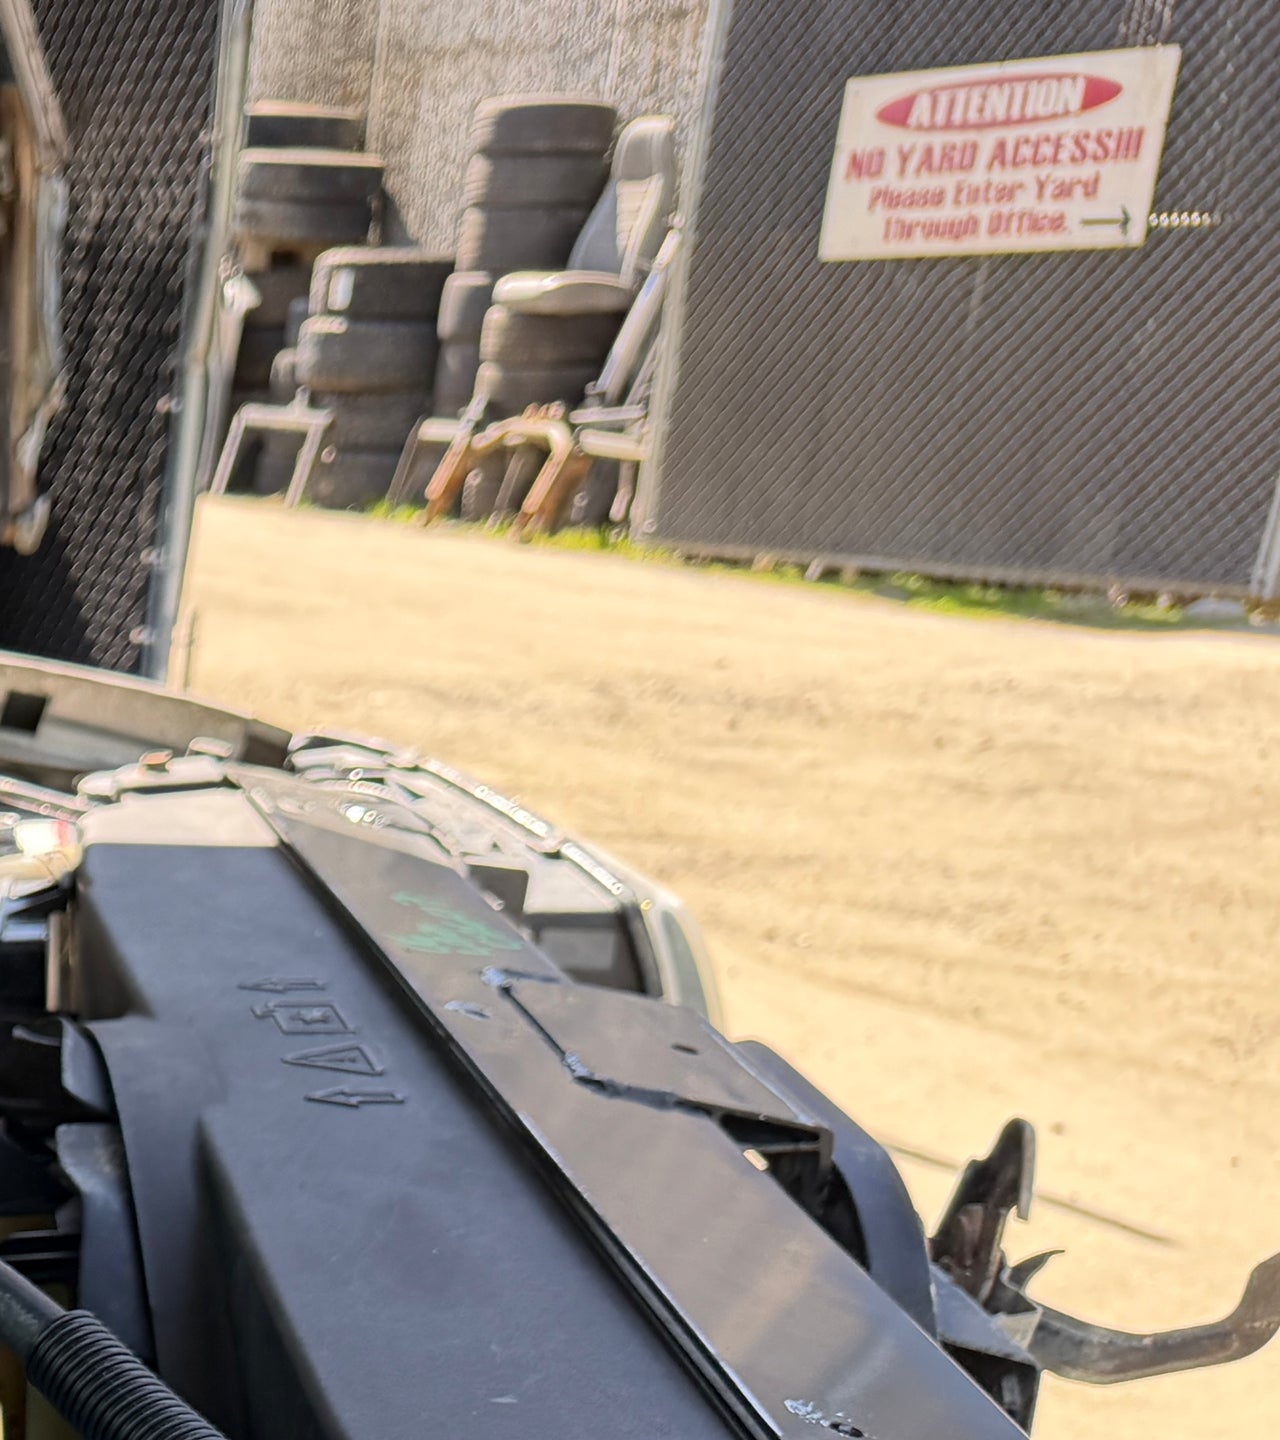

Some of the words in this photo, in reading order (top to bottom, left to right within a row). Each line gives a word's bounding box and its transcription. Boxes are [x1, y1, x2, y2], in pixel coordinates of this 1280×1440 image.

[906, 76, 1085, 129] ATTENTION
[845, 146, 886, 180] NO
[898, 140, 978, 176] YARD
[987, 127, 1146, 169] ACCESS!!!
[869, 182, 946, 212] Please
[954, 177, 1027, 205] Enter
[1036, 172, 1101, 200] Yard
[884, 213, 979, 244] Through
